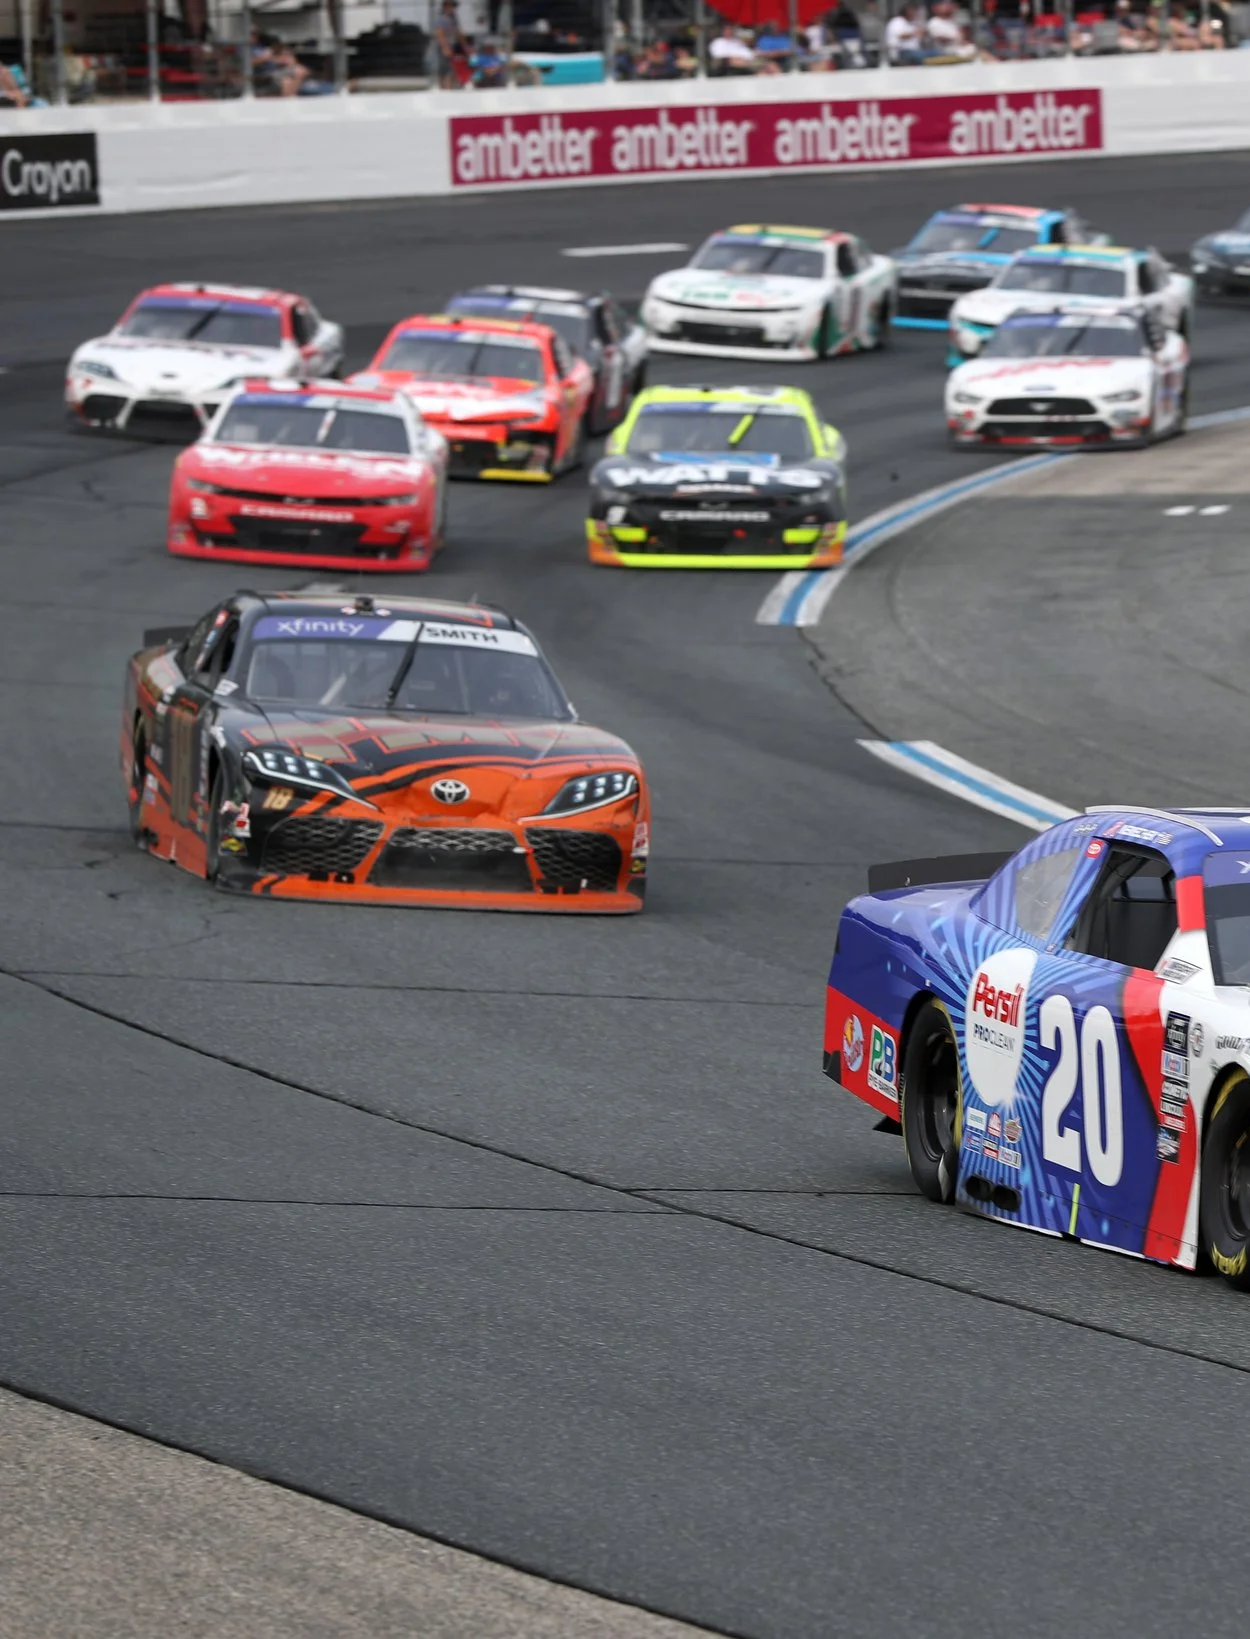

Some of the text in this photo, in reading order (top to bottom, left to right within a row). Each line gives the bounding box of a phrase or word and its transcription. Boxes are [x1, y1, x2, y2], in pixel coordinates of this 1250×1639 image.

[456, 115, 599, 180] ambetter
[611, 106, 755, 170] ambetter
[775, 103, 916, 164] ambetter
[950, 94, 1092, 154] ambetter
[2, 148, 92, 203] Crayon
[277, 618, 364, 636] xfinity
[427, 626, 498, 644] SMITH
[263, 787, 295, 810] 18
[972, 972, 1025, 1028] Persil
[1039, 994, 1124, 1187] 20
